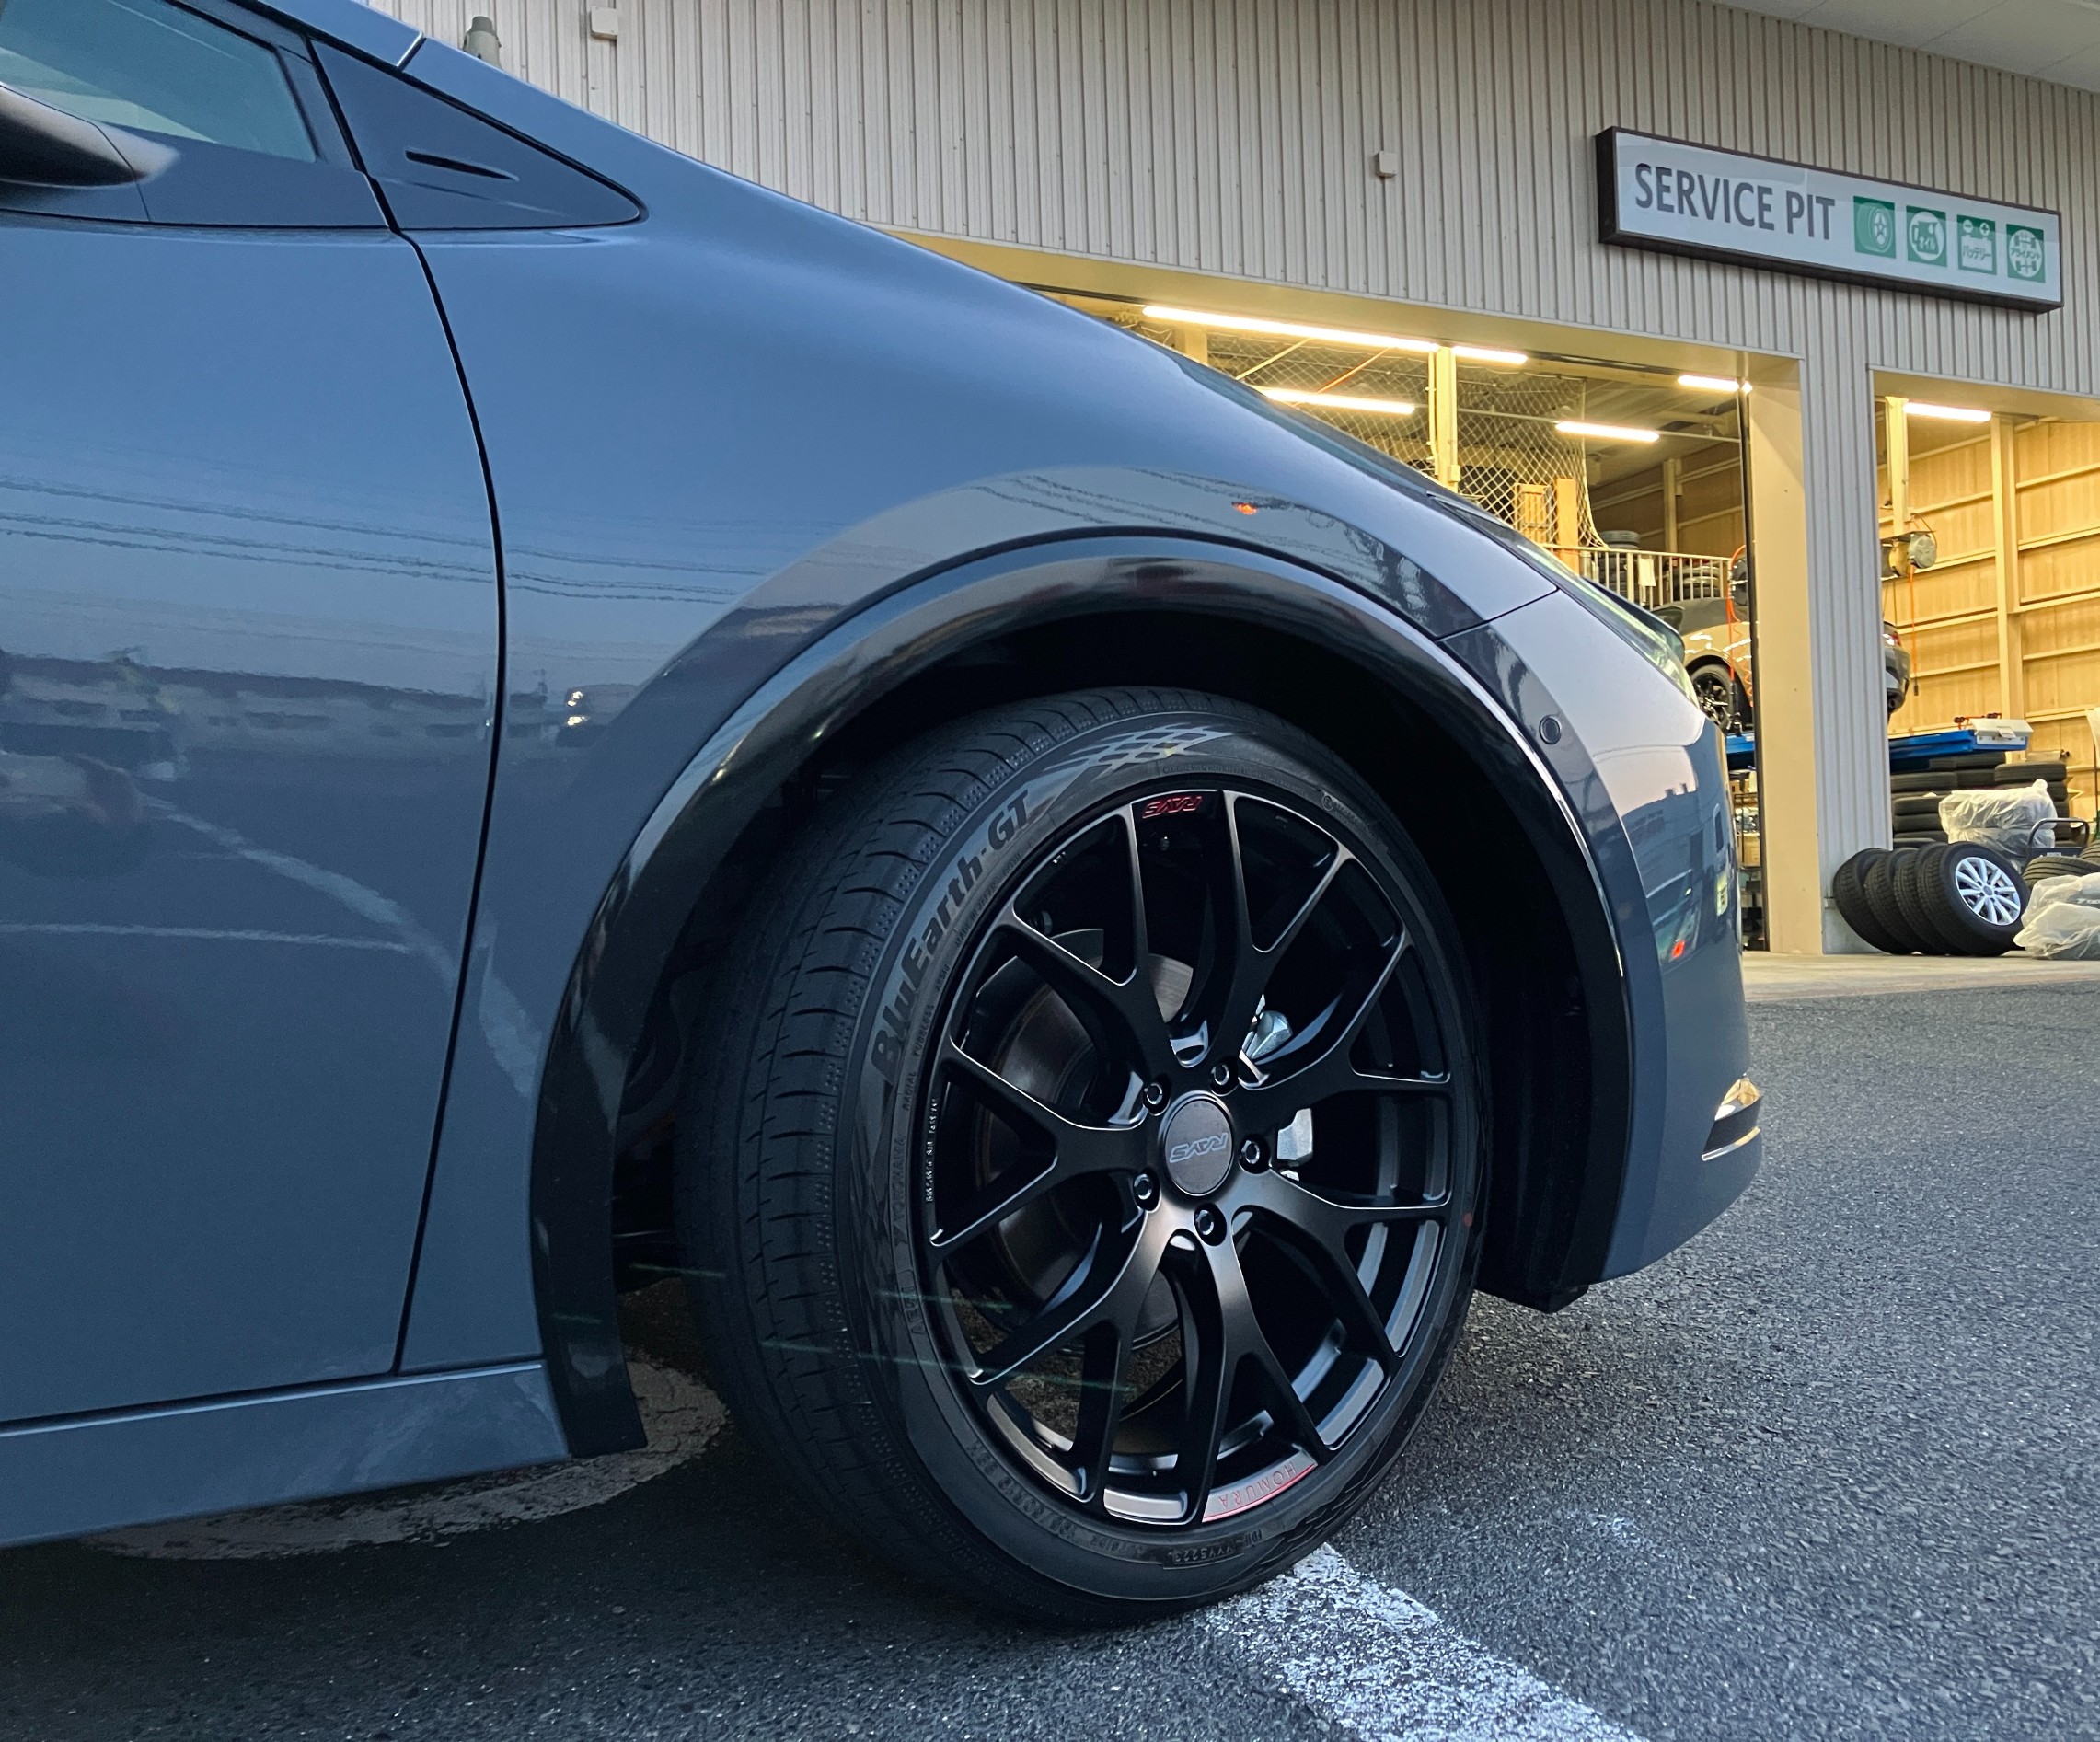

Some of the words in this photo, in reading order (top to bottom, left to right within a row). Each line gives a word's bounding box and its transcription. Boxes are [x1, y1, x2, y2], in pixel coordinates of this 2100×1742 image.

[1634, 162, 1775, 231] SERVICE
[1785, 190, 1836, 240] PIT
[1962, 245, 1991, 260] バッテリー
[1142, 795, 1202, 819] RAYS
[1168, 1132, 1229, 1164] RAYS
[1217, 1461, 1298, 1508] HOMURA
